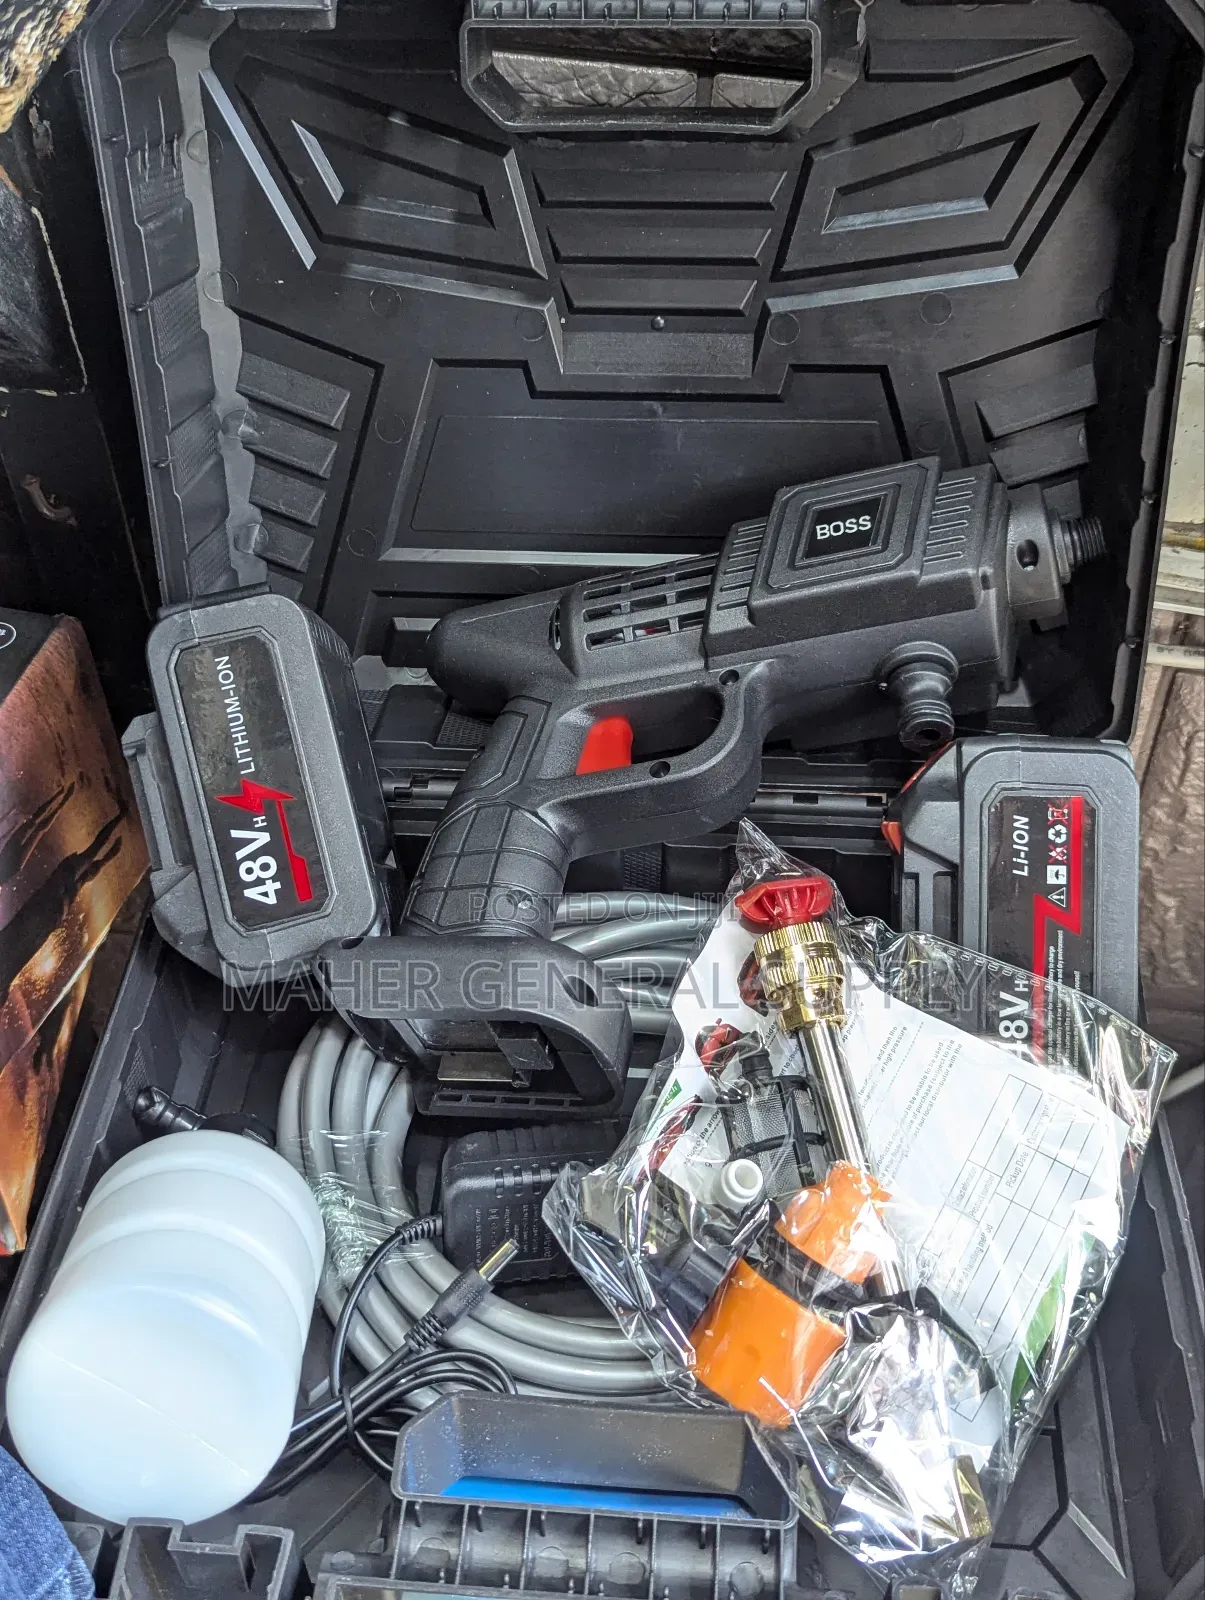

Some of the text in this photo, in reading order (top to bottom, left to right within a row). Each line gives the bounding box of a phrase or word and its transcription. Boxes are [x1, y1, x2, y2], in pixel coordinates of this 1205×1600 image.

[816, 515, 871, 540] BOSS
[214, 655, 255, 775] LITHIUM-ION
[882, 1025, 908, 1066] high pressure
[908, 1095, 916, 1104] be
[912, 1074, 928, 1096] unable
[914, 1083, 933, 1113] purchase
[1004, 1150, 1029, 1188] Pickup Date
[975, 1222, 993, 1247] metod
